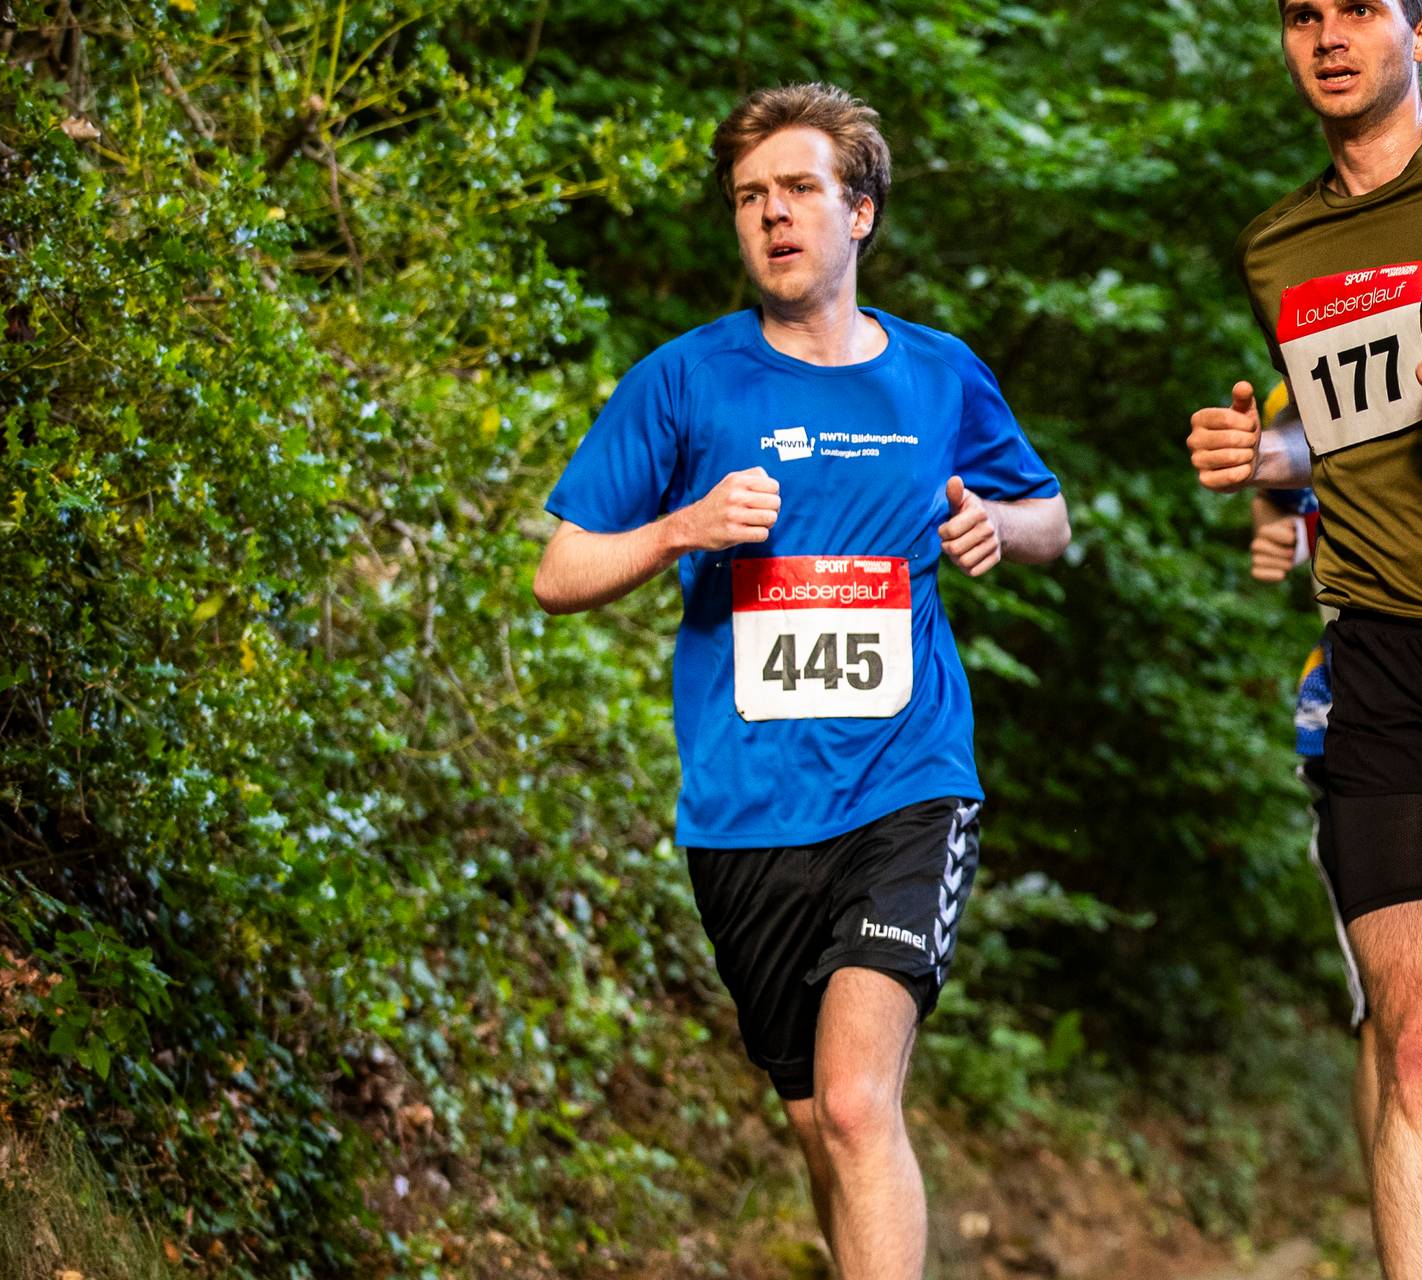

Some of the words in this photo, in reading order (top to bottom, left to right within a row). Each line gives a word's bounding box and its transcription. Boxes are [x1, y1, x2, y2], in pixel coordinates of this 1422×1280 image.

[1344, 270, 1376, 286] SPORT
[1296, 281, 1407, 327] Lousberglauf
[1310, 334, 1402, 420] 177
[819, 432, 850, 442] RWTH
[851, 434, 919, 445] Bildungsfonds
[862, 448, 880, 457] 2023
[815, 560, 850, 574] SPORT
[757, 581, 888, 604] Lousberglauf
[762, 632, 883, 691] 445
[861, 918, 926, 951] hummel
